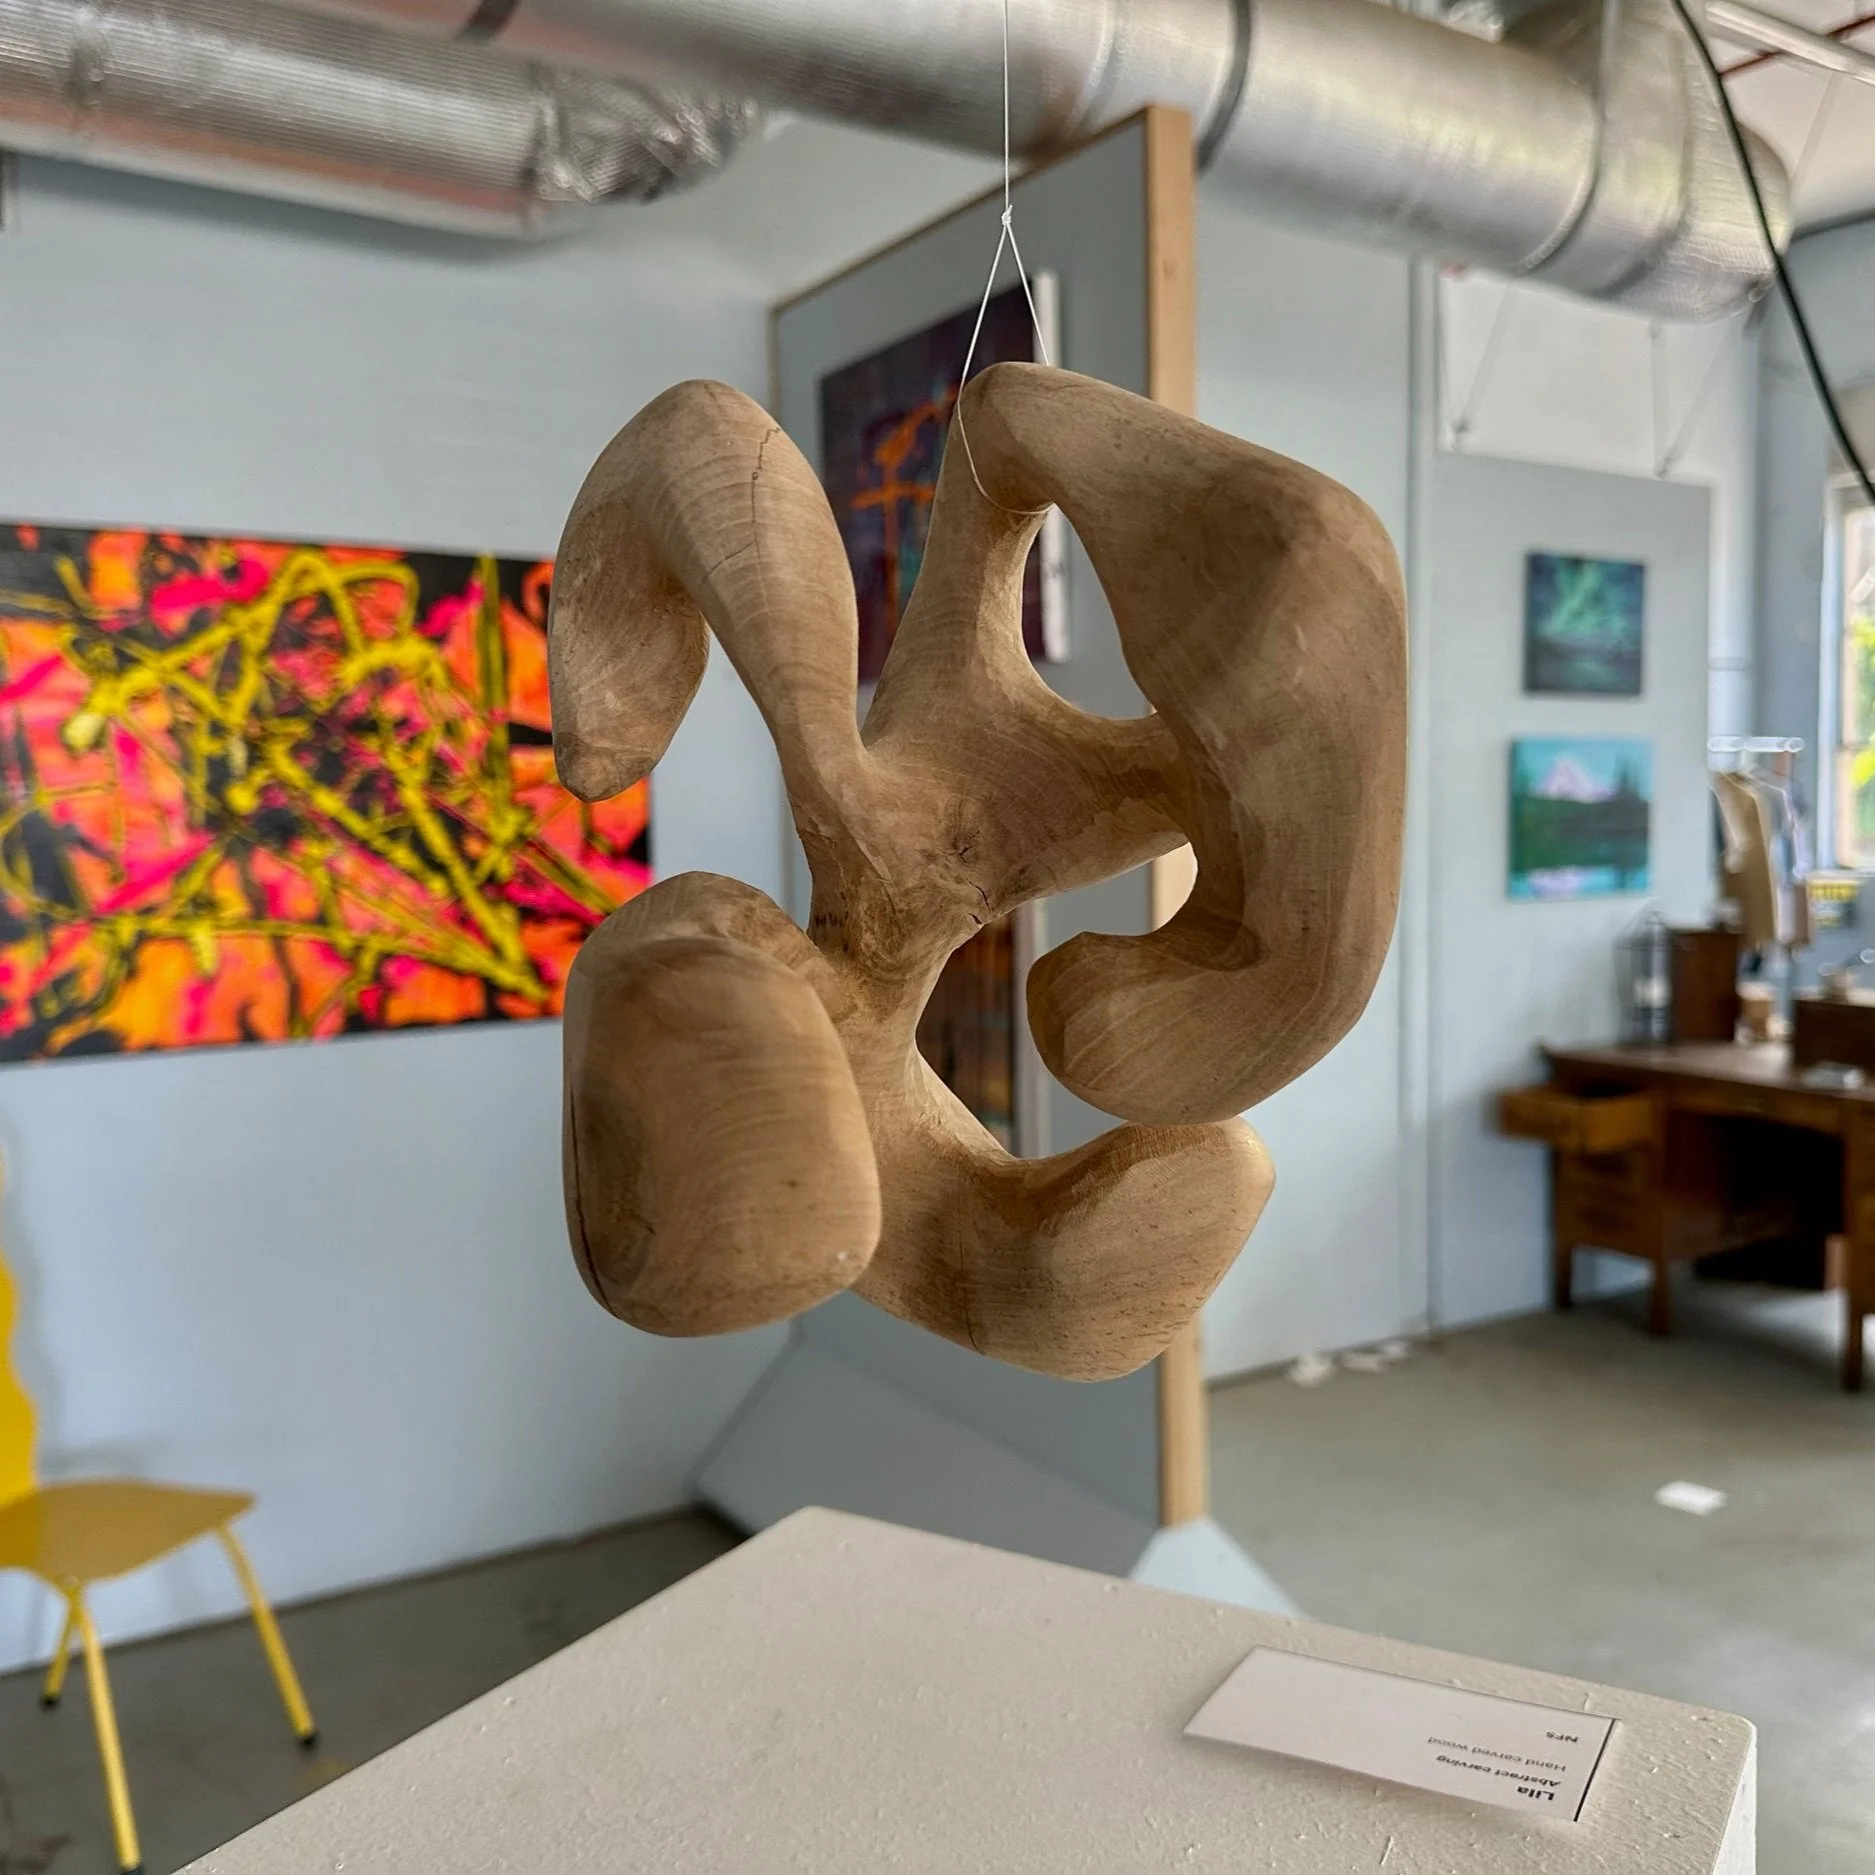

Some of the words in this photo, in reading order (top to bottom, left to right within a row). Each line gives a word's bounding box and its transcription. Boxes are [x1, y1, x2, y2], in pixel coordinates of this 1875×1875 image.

[1427, 1736, 1468, 1751] wood
[1545, 1730, 1579, 1743] NFS
[1471, 1746, 1522, 1763] carved
[1436, 1754, 1491, 1773] carving
[1524, 1758, 1566, 1773] Hand
[1494, 1768, 1562, 1787] Abstract
[1517, 1785, 1555, 1801] Lila
